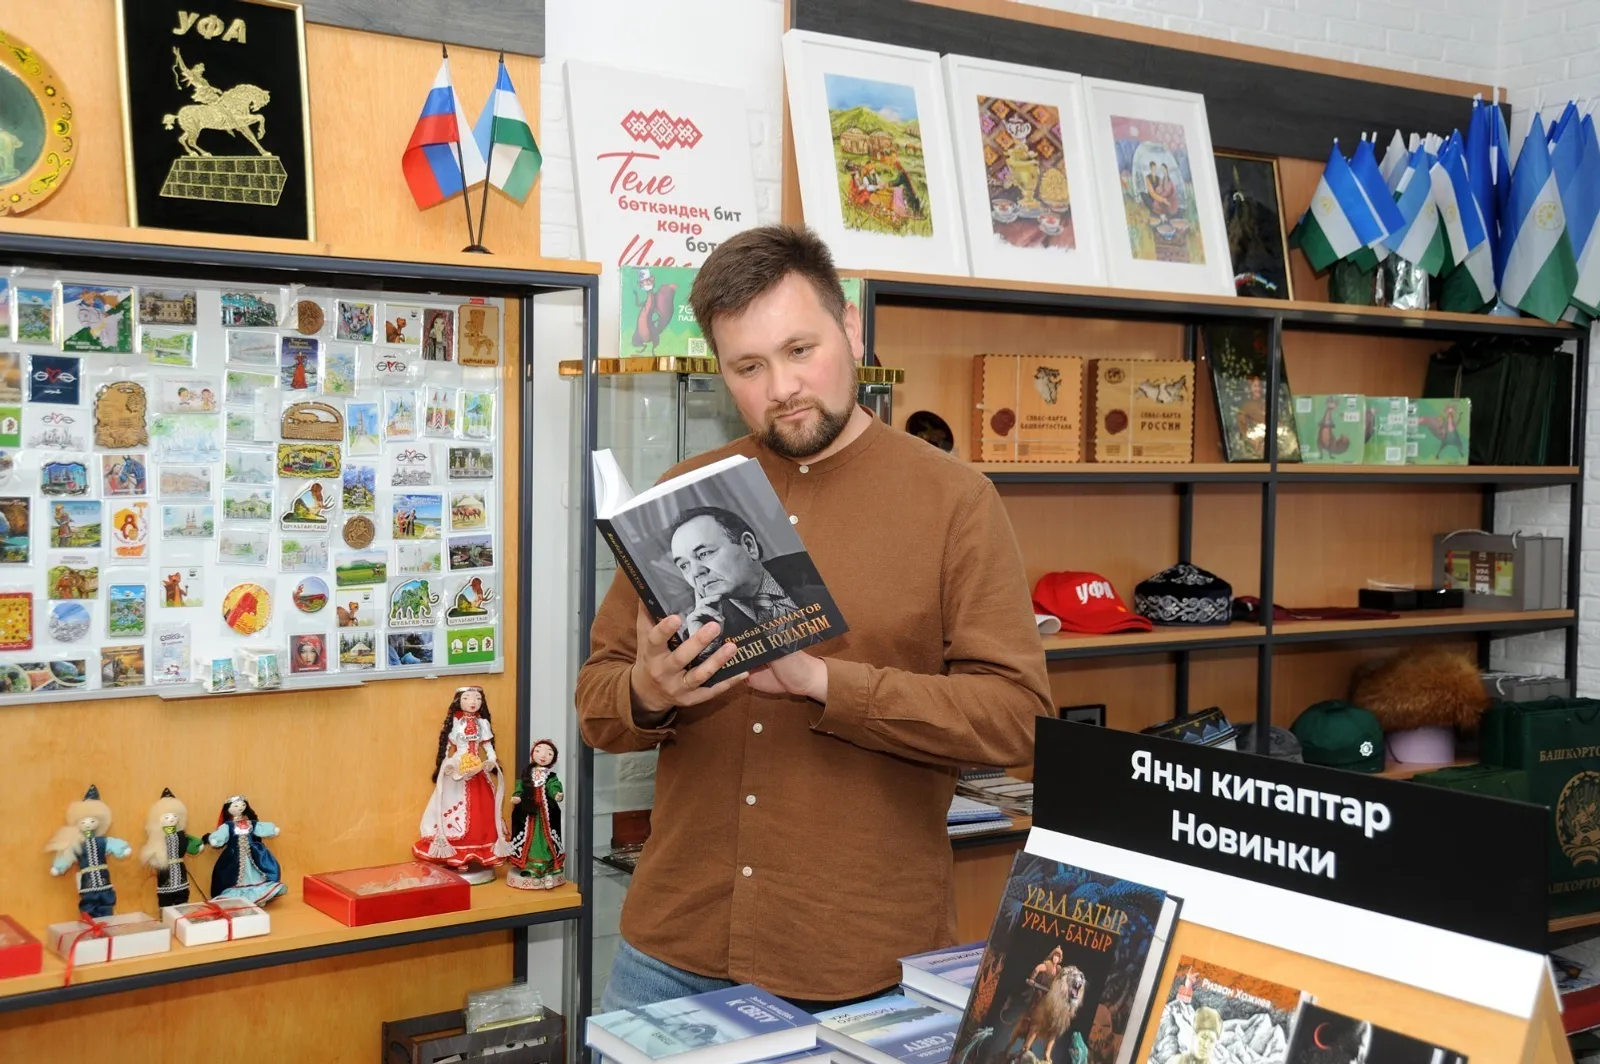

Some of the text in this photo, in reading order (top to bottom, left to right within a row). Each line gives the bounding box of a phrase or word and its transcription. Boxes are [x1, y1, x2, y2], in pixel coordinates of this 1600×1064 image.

[172, 10, 247, 44] УФА
[597, 151, 676, 195] Теле
[618, 195, 741, 222] бөткәндең бит
[657, 219, 702, 235] көнө
[686, 236, 722, 253] бөт
[1140, 421, 1181, 431] РОССИИ
[1075, 580, 1115, 605] УФА
[760, 602, 822, 631] ХАММАТОВ
[1131, 750, 1392, 839] Яңы китаптар
[1171, 809, 1337, 879] Новинки
[1022, 883, 1129, 935] УРАЛ БАТЫР
[1021, 910, 1112, 953] УРАЛ-БАТЫР
[1202, 978, 1234, 997] Ризван
[737, 1005, 780, 1023] СВЕТУ
[902, 1035, 947, 1053] СВЕТУ
